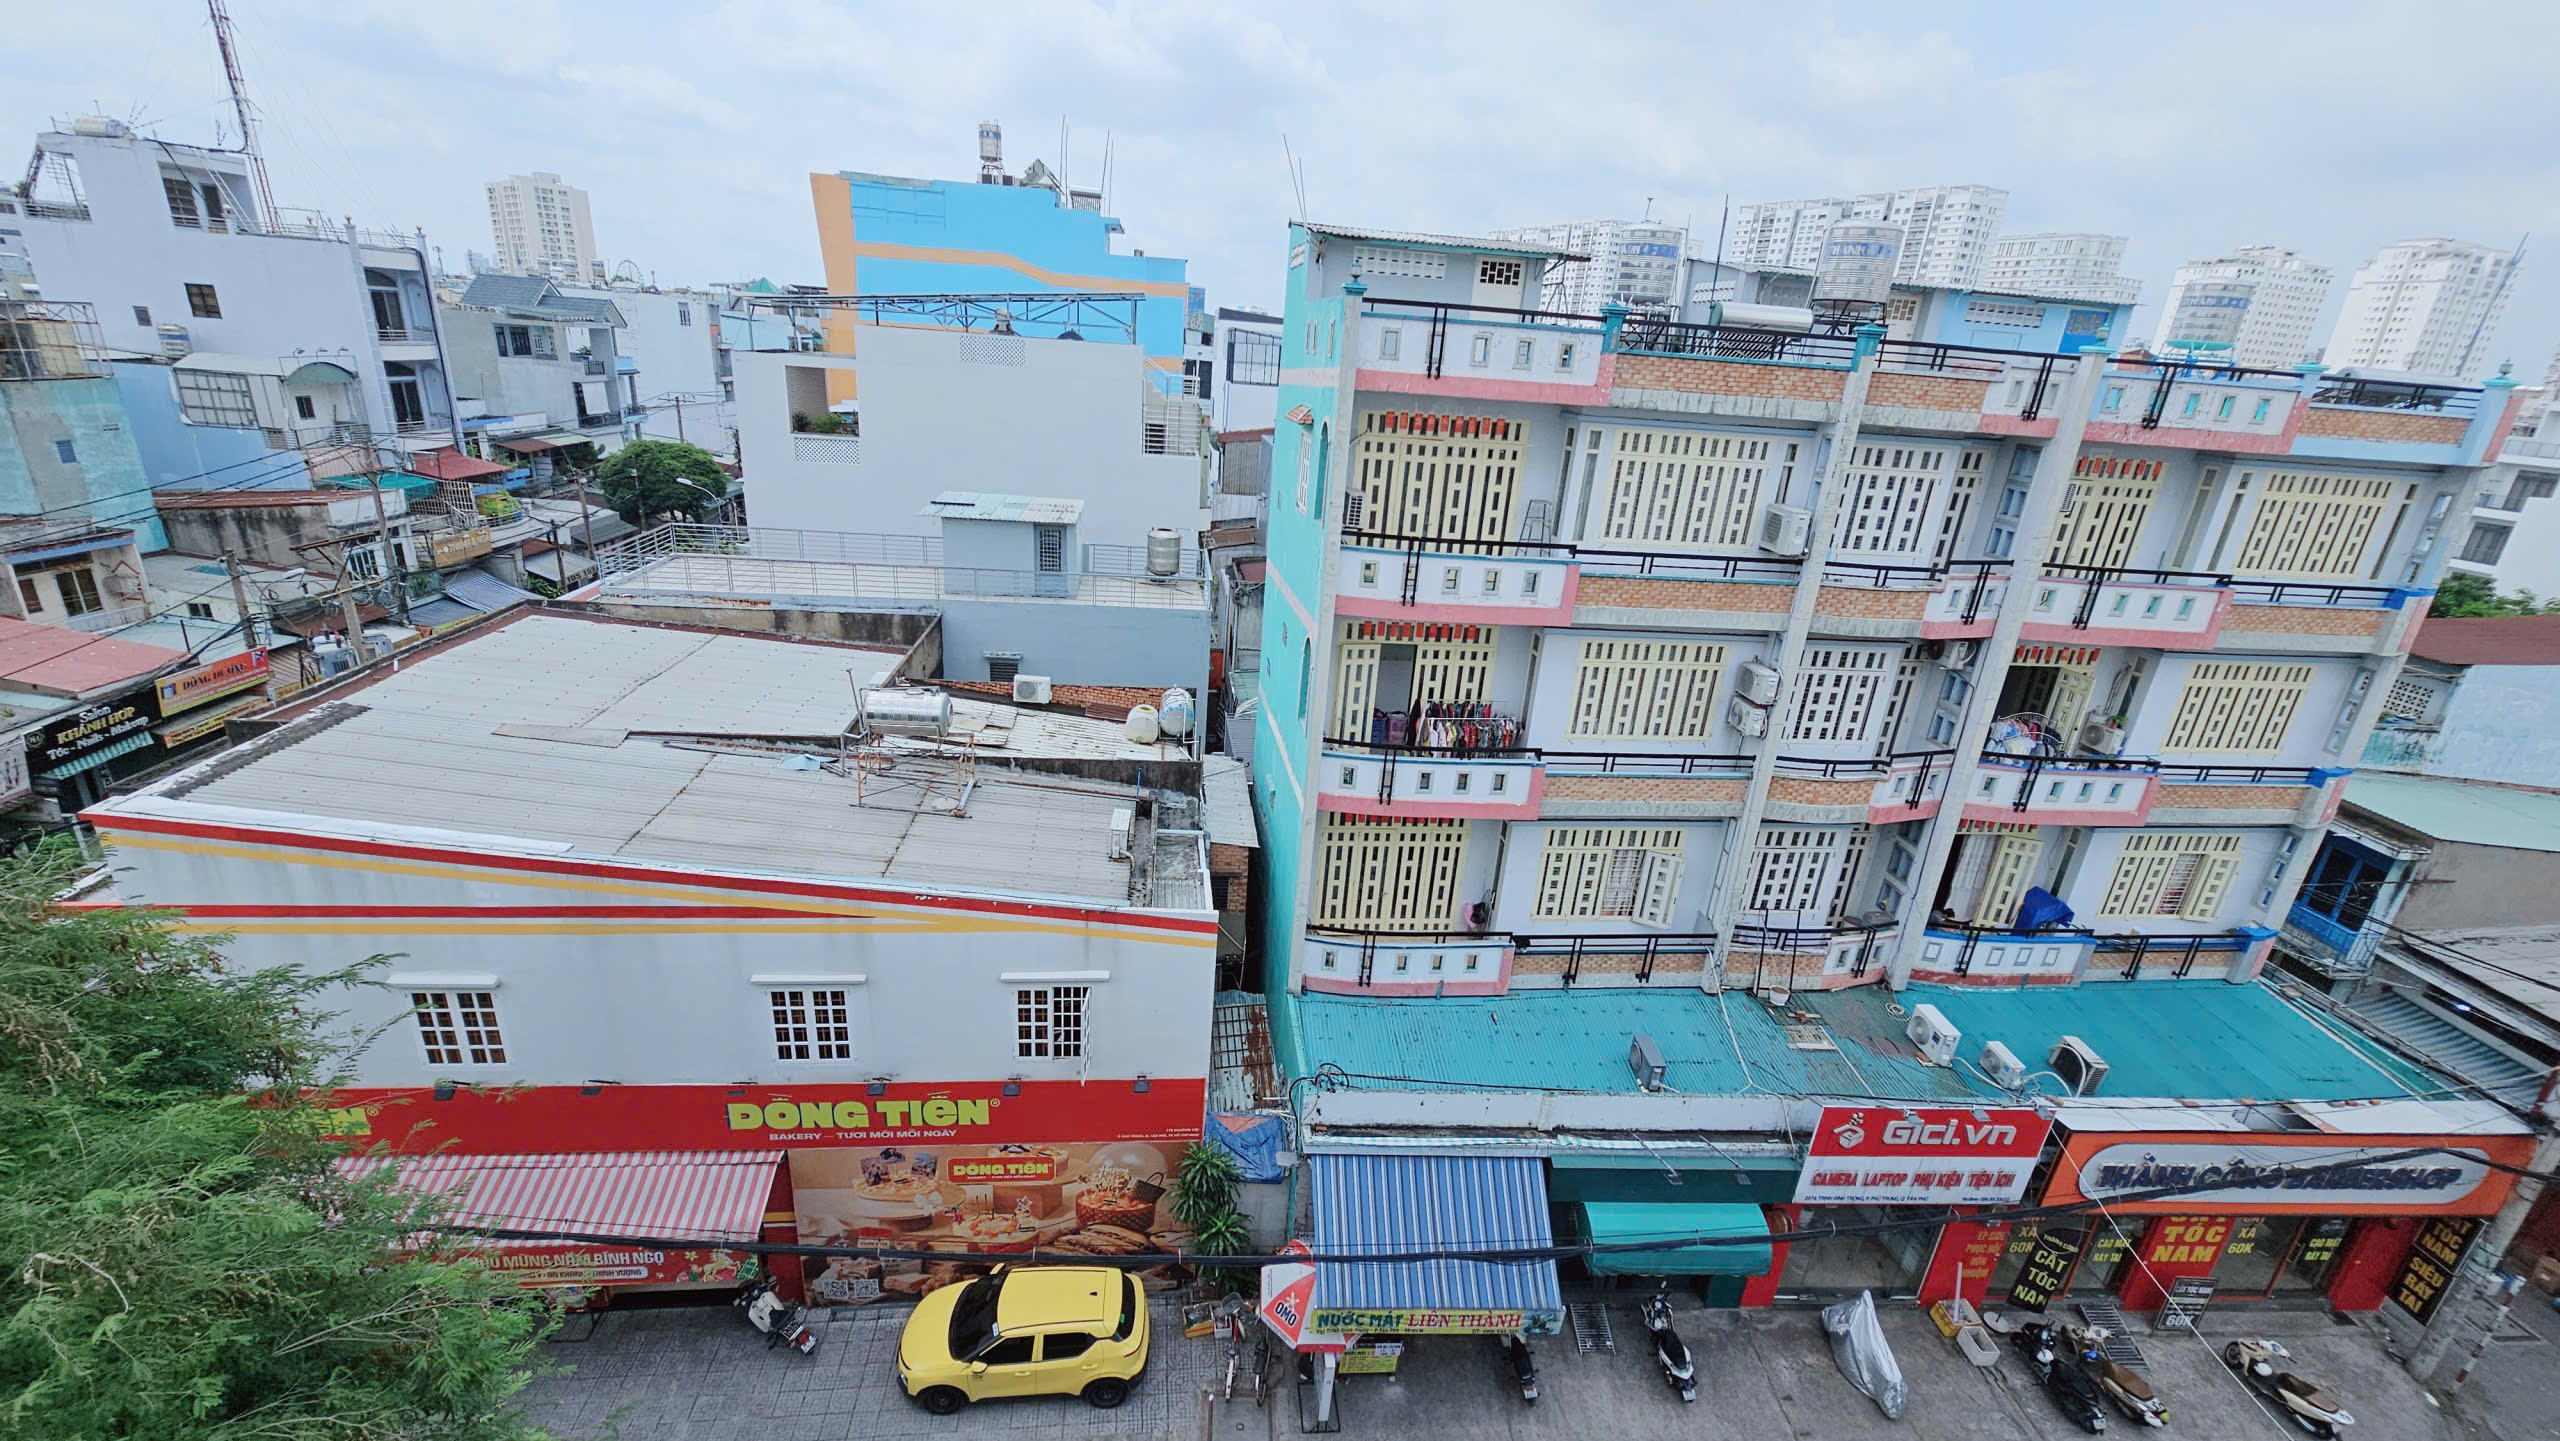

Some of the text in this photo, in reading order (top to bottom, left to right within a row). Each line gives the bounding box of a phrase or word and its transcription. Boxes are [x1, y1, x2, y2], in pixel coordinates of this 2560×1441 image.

[79, 706, 111, 723] Salon
[76, 733, 105, 750] Nails
[109, 716, 149, 737] Makeup
[769, 1128, 957, 1141] BAKERY TƯƠI MỚI MỖI NGÀY
[1811, 1168, 2017, 1191] CAMERA LAPTOP PHỤ KIỆN TIỆN ÍCH
[2096, 1152, 2198, 1188] THÀNH
[2164, 1222, 2226, 1243] TÓC
[2433, 1222, 2463, 1250] TÓC
[593, 1250, 631, 1265] BÍNH
[632, 1251, 665, 1266] NGỌ
[2151, 1245, 2217, 1262] NAM
[2227, 1242, 2255, 1254] 60K
[2420, 1232, 2458, 1265] NAM
[2028, 1266, 2058, 1291] TÓC
[2014, 1284, 2048, 1306] NAM
[2398, 1287, 2423, 1313] TAI
[1275, 1301, 1298, 1328] OMO
[1317, 1309, 1522, 1328] NƯỚC MÁT LIÊN THÀNH
[2165, 1314, 2195, 1327] 60K
